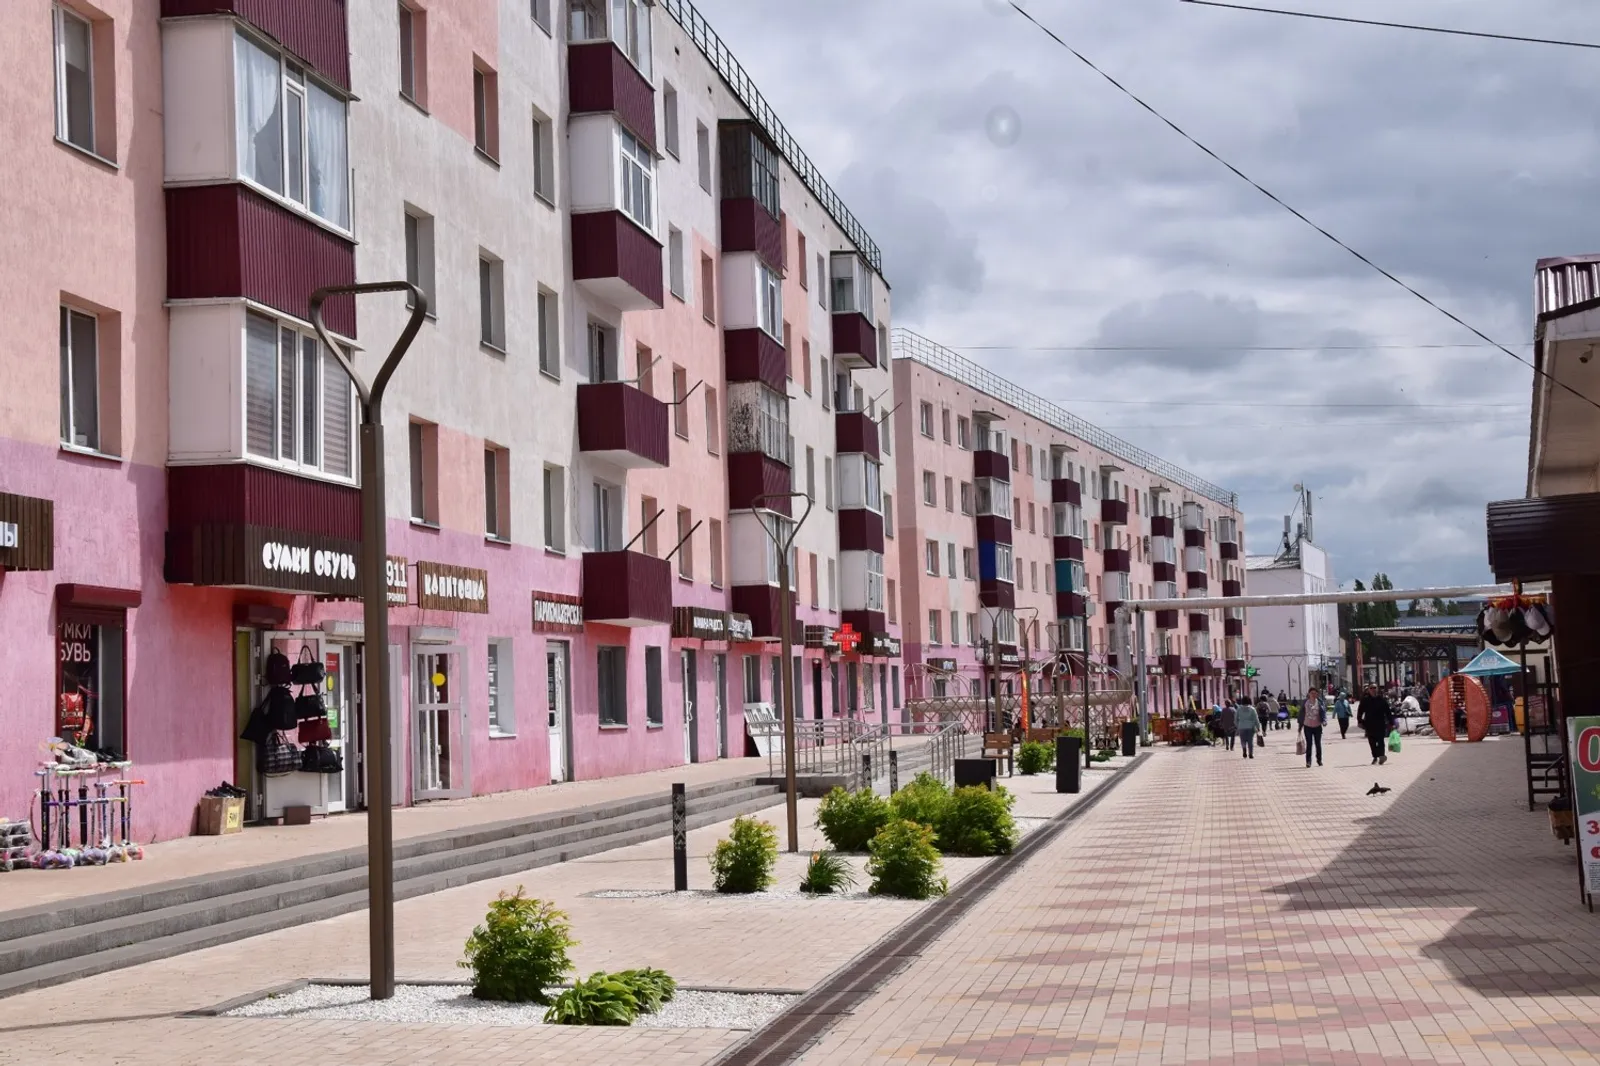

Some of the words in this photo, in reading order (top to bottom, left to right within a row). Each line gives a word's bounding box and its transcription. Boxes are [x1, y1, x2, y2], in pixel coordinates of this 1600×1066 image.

[262, 542, 310, 575] СУМКИ
[314, 549, 356, 580] ОБУВЬ
[386, 560, 407, 588] 911
[424, 572, 485, 601] КАПИТОШКА
